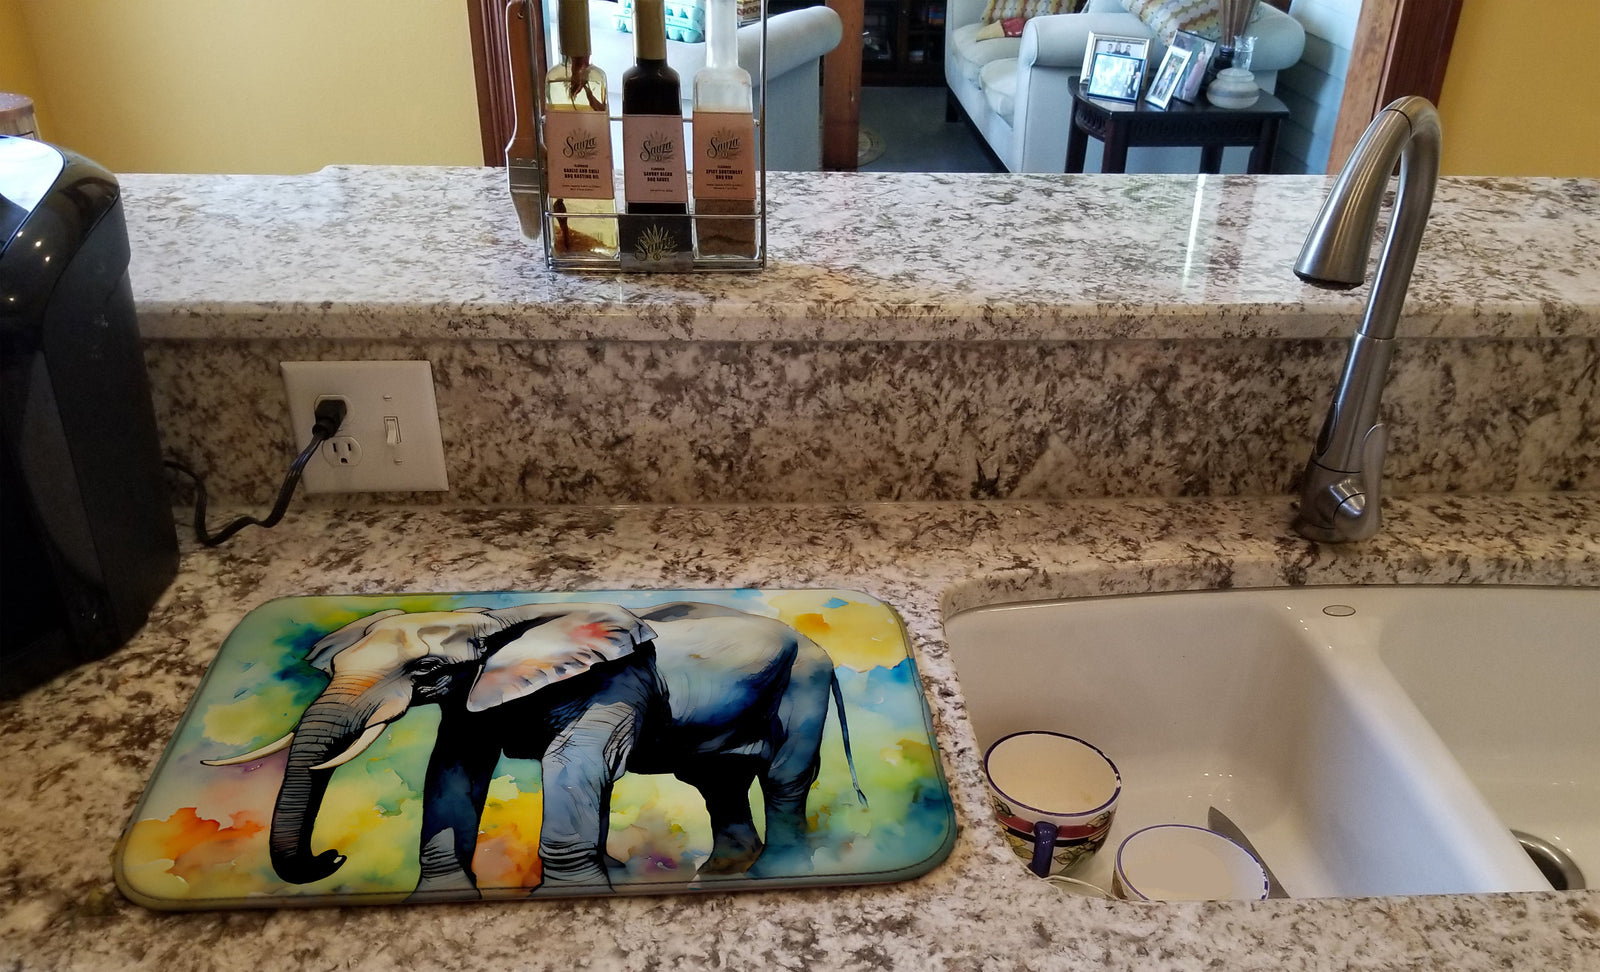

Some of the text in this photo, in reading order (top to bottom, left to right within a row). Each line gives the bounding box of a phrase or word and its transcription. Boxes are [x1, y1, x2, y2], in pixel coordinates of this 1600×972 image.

[563, 136, 598, 158] Sauza
[640, 140, 673, 161] Sauza
[707, 137, 741, 158] Sauza
